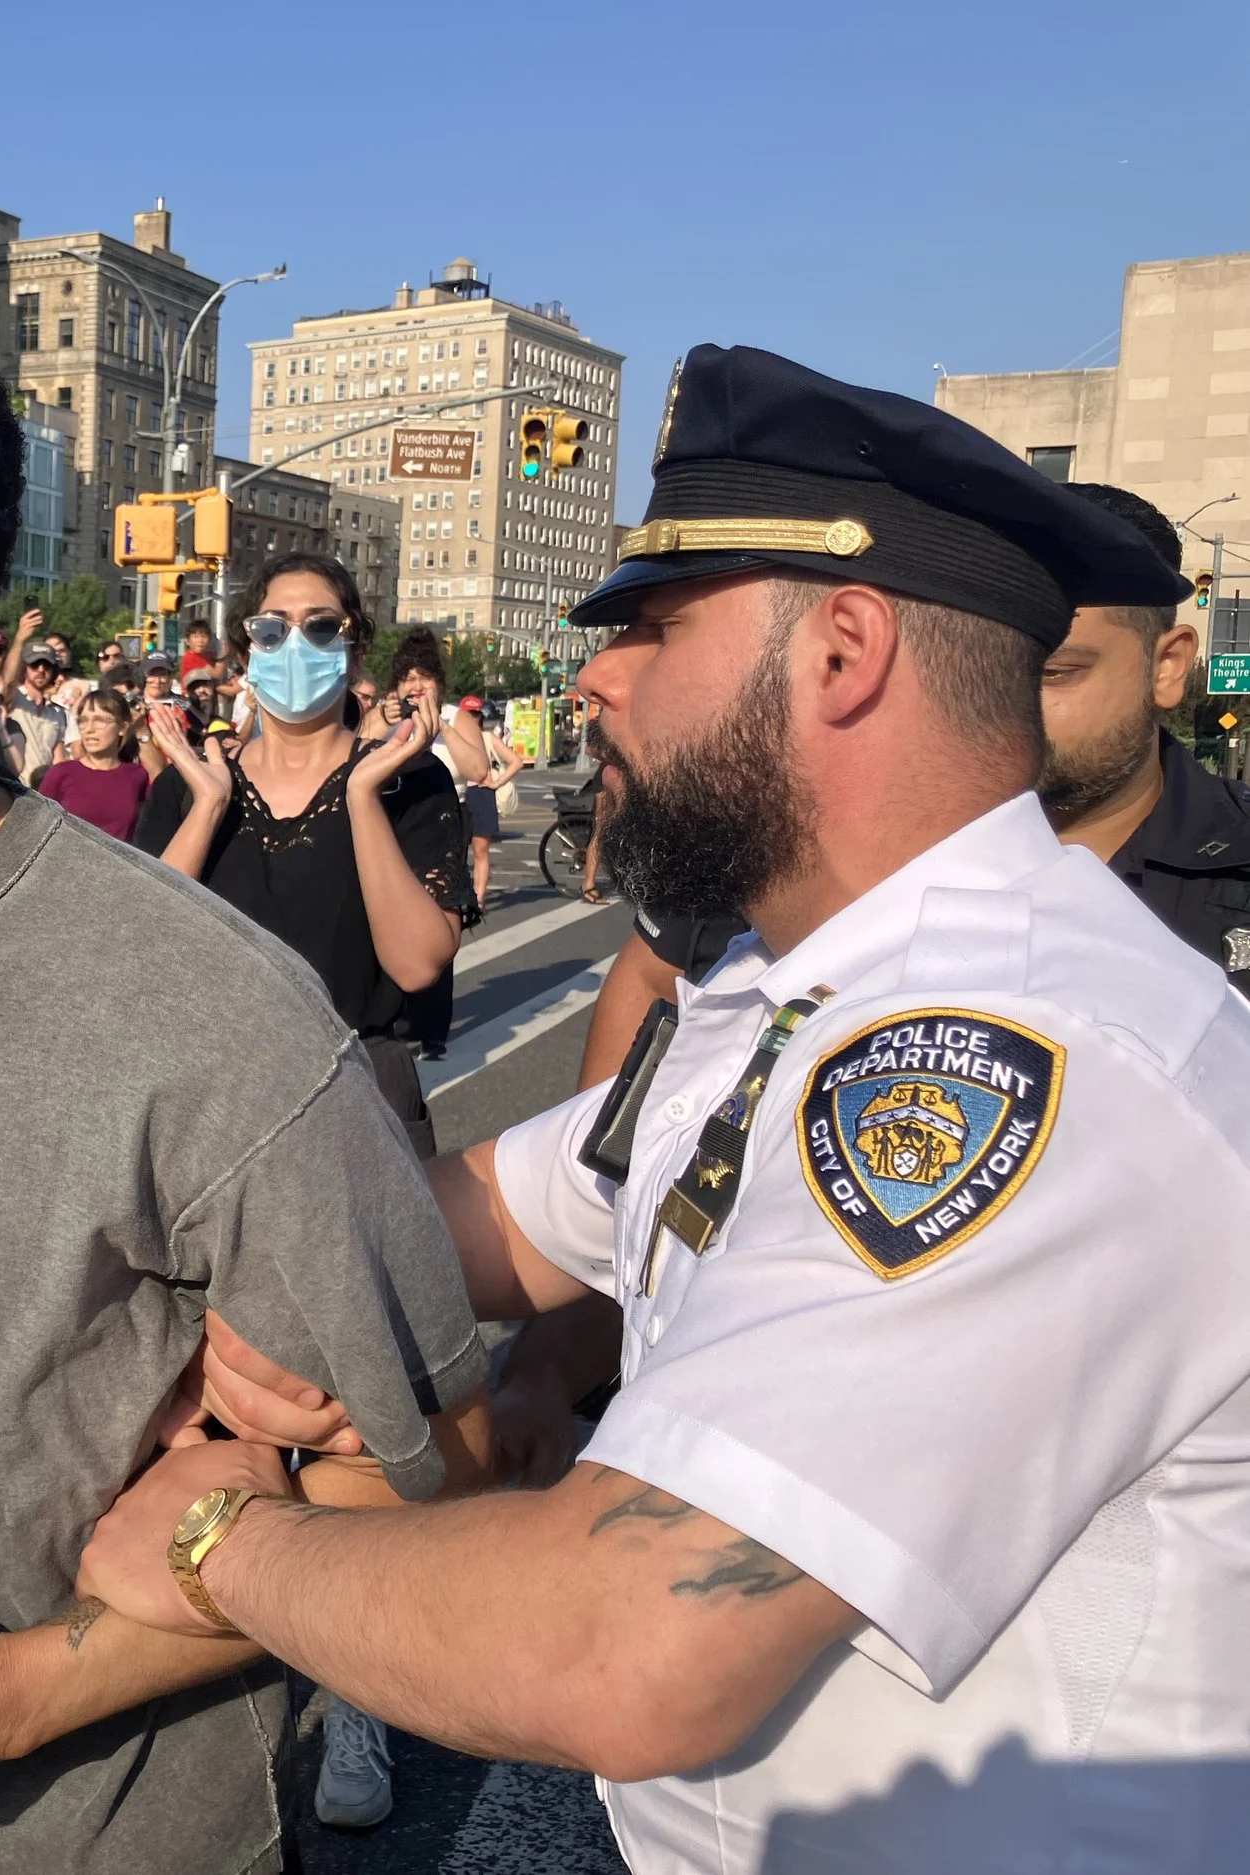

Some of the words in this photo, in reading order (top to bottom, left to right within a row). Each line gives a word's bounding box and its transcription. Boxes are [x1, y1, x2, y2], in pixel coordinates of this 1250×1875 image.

[396, 433, 450, 446] Vanderbilt
[452, 435, 471, 447] Ave
[399, 446, 444, 459] Flatbush
[446, 448, 466, 460] Ave
[430, 463, 462, 475] NORTH
[1218, 658, 1246, 669] Kings
[1213, 668, 1250, 677] Theatre
[868, 1023, 990, 1055] POLICE
[821, 1047, 1034, 1099] DEPARTMENT
[810, 1119, 842, 1173] CITY
[831, 1178, 867, 1217] OF
[914, 1188, 978, 1244] NEW
[970, 1119, 1036, 1192] YORK
